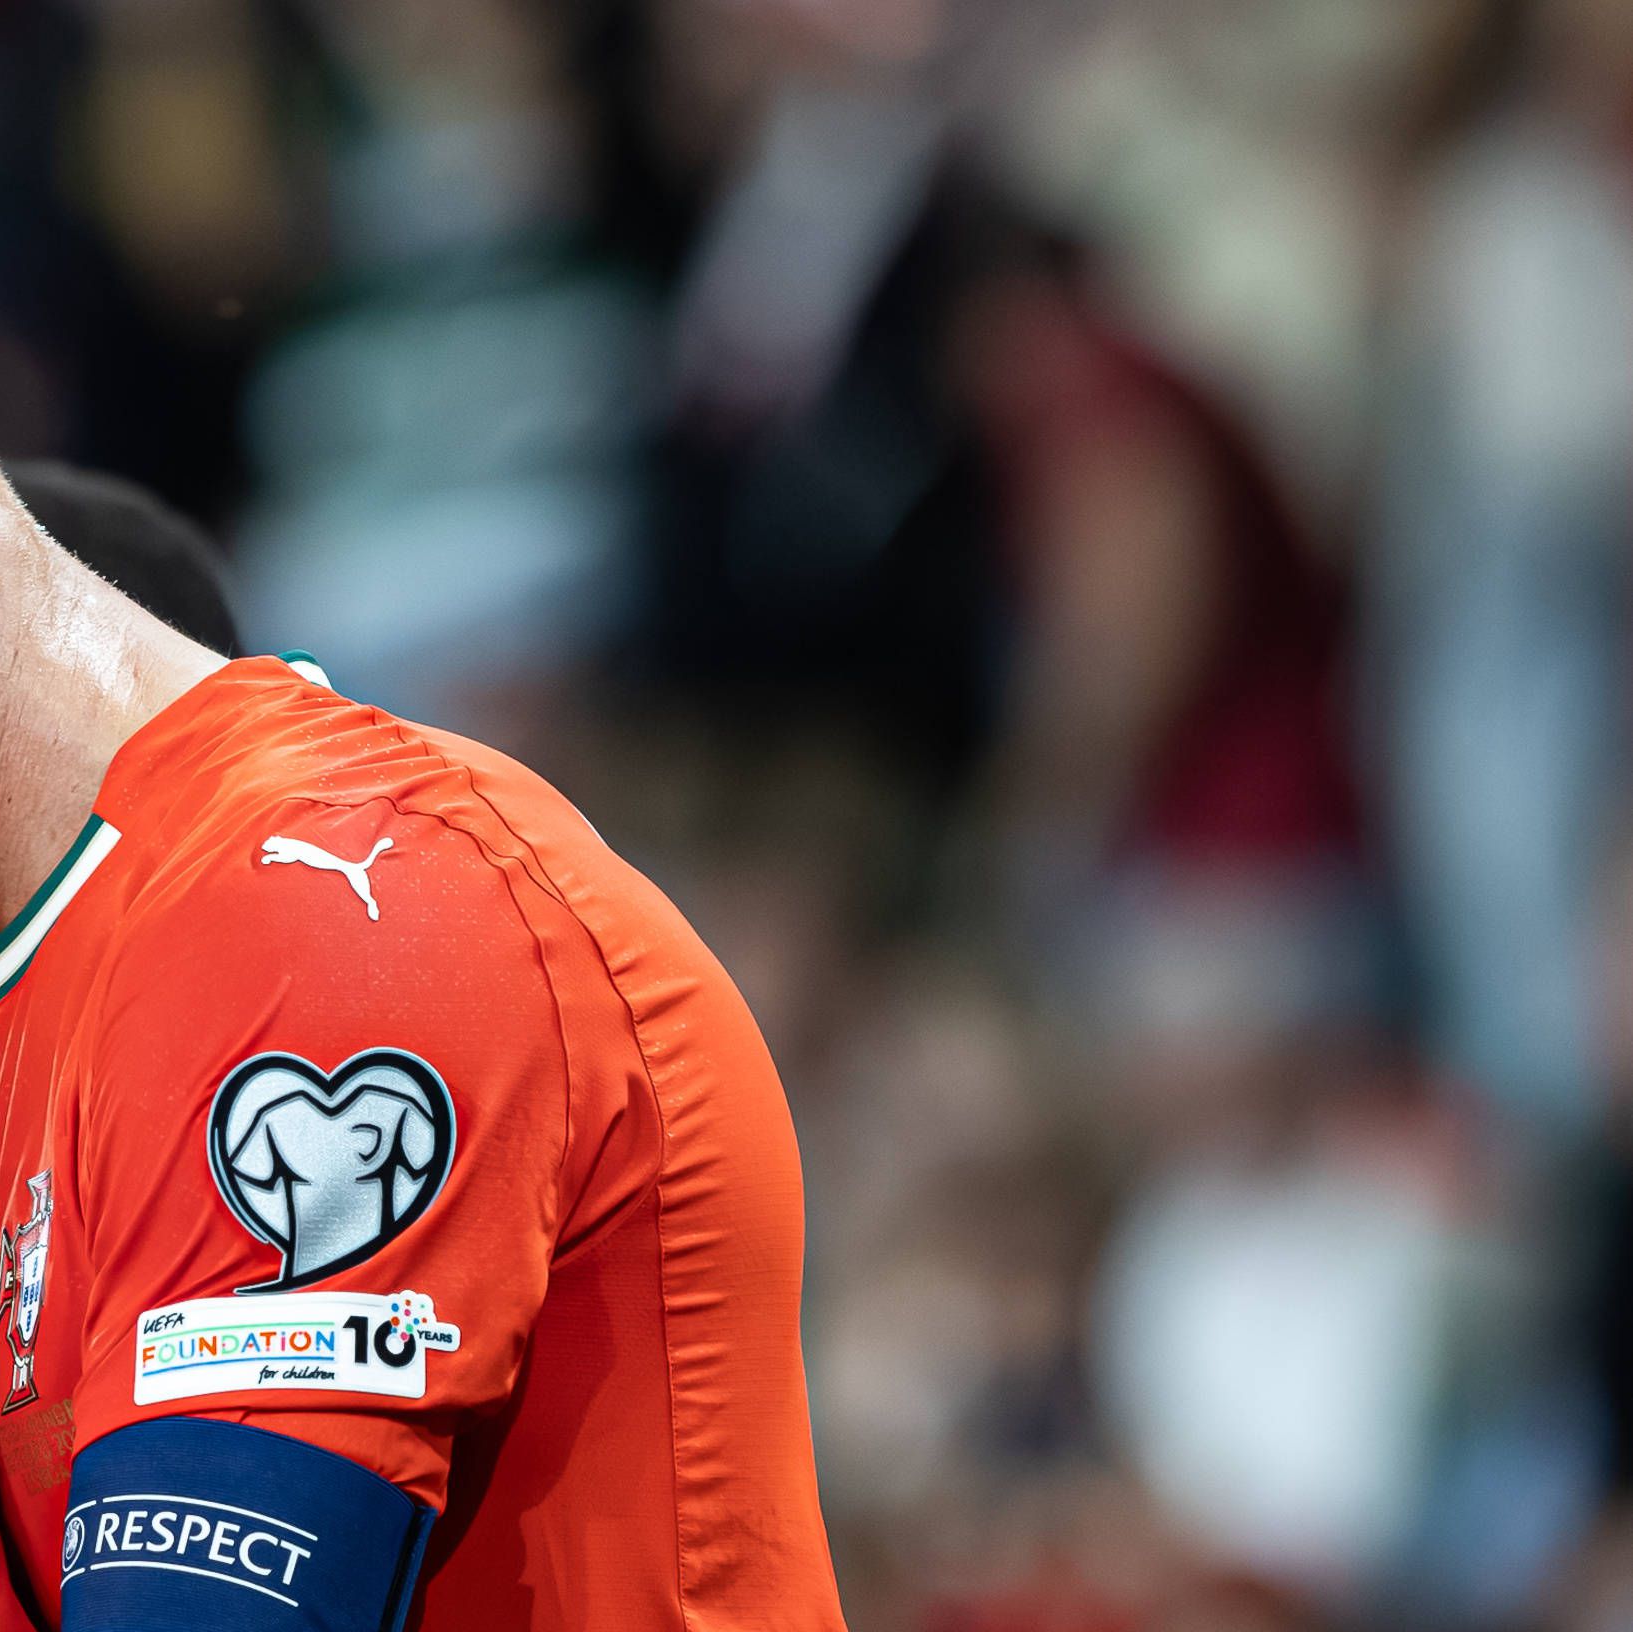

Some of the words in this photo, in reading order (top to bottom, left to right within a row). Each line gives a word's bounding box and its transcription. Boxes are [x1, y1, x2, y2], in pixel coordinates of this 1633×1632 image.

[143, 1313, 185, 1335] UEFA
[343, 1314, 416, 1368] 10
[417, 1329, 453, 1344] YEARS
[258, 1365, 280, 1384] for
[282, 1366, 335, 1380] children
[94, 1510, 311, 1586] RESPECT
